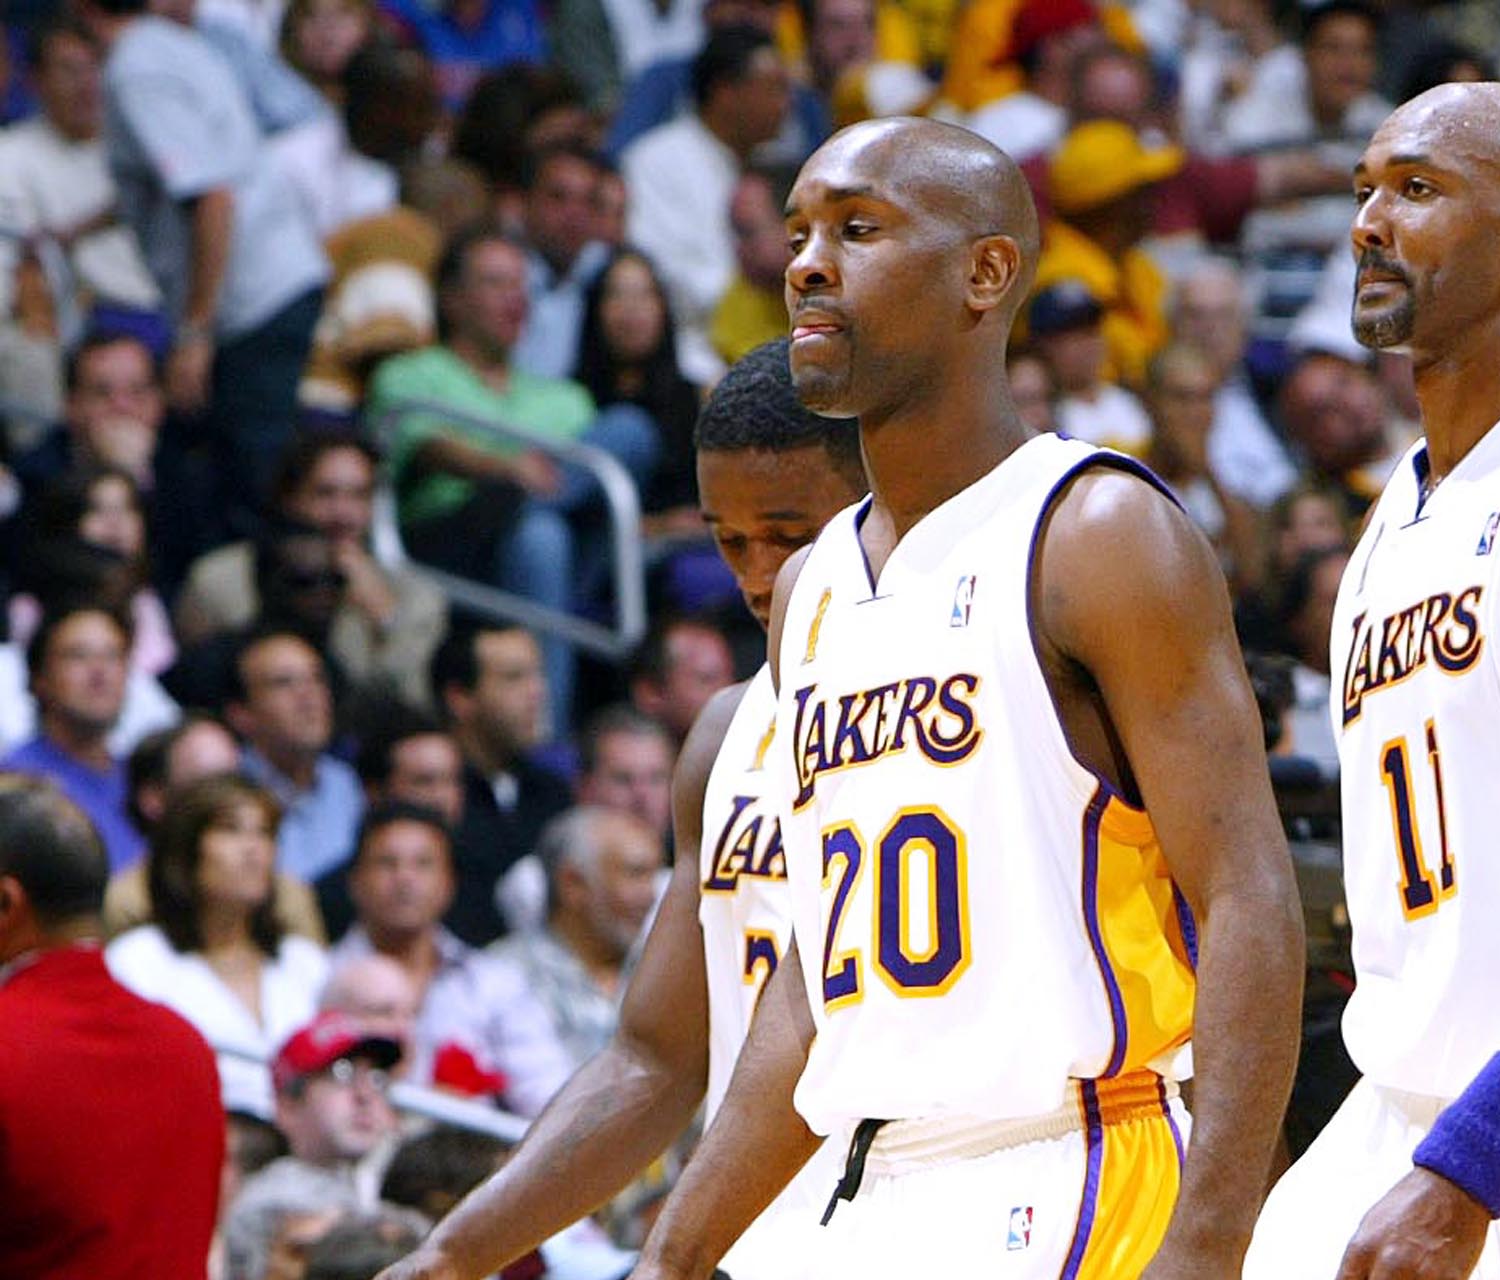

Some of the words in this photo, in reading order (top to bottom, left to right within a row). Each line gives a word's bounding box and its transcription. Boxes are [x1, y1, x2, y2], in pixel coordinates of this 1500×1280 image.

[792, 673, 984, 816] LAKERS
[1343, 586, 1484, 731] LAKERS
[1379, 717, 1458, 923] 11
[820, 804, 973, 1019] 20
